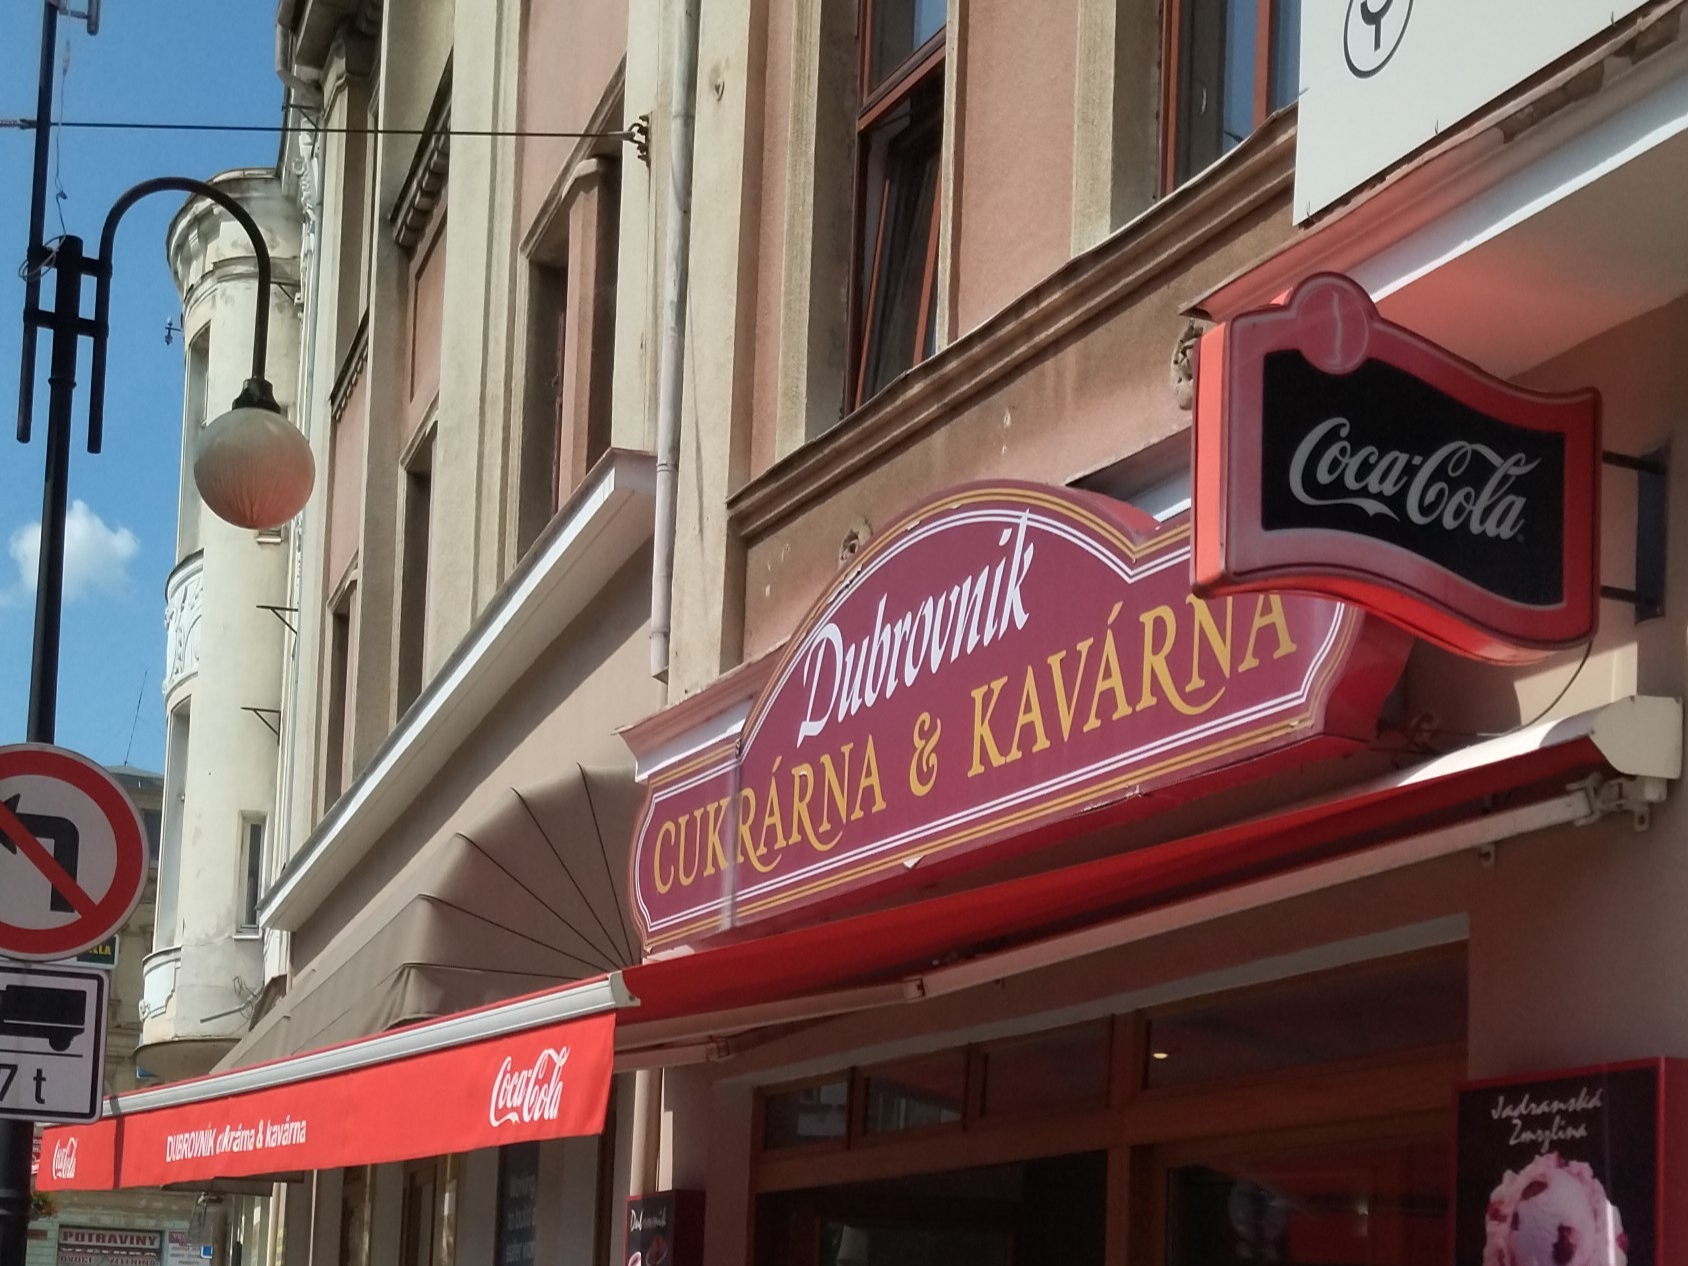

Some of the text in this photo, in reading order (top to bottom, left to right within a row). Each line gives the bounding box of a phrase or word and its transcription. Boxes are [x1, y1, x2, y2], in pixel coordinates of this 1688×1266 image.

[1289, 417, 1541, 541] Coca-Cola
[797, 508, 1034, 748] Dubrovnik
[654, 593, 1298, 895] CUKRÁRNA & KAVÁRNA
[33, 1068, 47, 1105] t
[489, 1046, 571, 1128] Coca-Cola
[256, 1119, 265, 1149] &
[265, 1114, 307, 1148] kavárna
[62, 1230, 158, 1248] POTRAVINY
